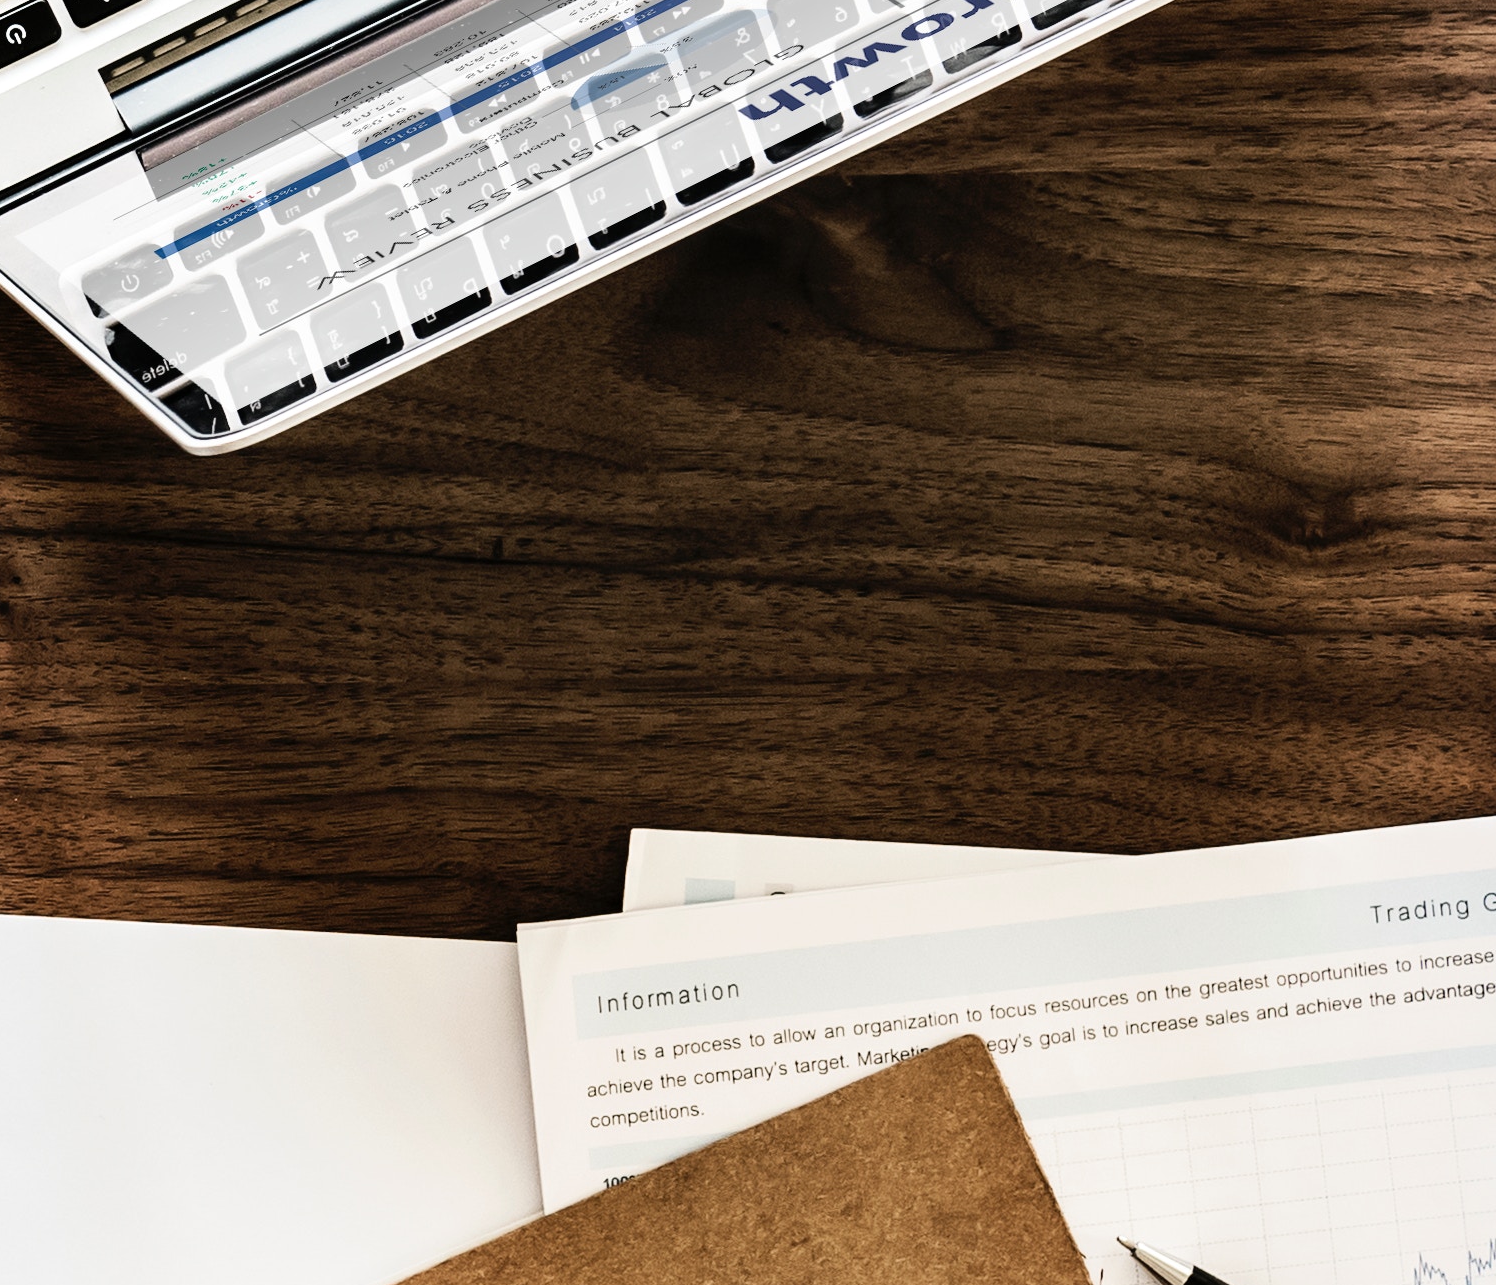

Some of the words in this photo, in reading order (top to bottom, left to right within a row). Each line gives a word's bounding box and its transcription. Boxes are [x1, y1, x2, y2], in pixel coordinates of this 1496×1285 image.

[1370, 899, 1469, 924] Trading
[598, 983, 739, 1014] Information
[590, 1105, 705, 1128] competitions.
